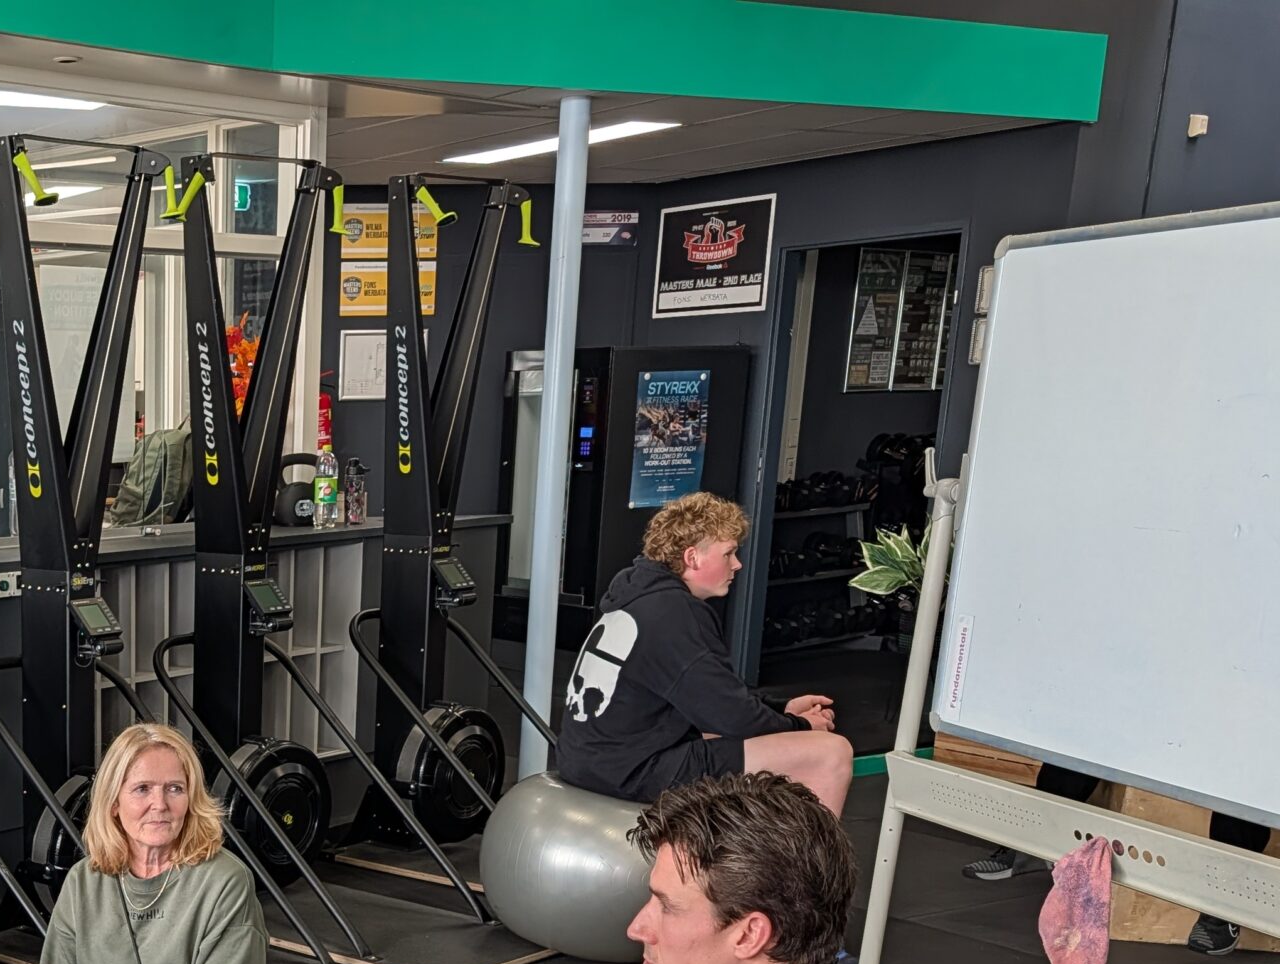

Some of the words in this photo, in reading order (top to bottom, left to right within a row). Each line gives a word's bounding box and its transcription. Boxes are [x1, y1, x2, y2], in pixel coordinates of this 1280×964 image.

[611, 214, 632, 223] 2019
[692, 246, 734, 260] THROWDOWN
[660, 279, 694, 292] MASTERS
[695, 277, 717, 289] MALE
[723, 275, 739, 286] 2ND
[739, 273, 763, 284] PLACE
[13, 319, 25, 336] 2
[195, 321, 207, 336] 2
[395, 325, 407, 339] 2
[198, 341, 216, 450] concept
[396, 343, 410, 442] concept
[647, 380, 701, 395] STYREKX
[15, 340, 37, 459] concept
[950, 626, 968, 709] Fundamentals
